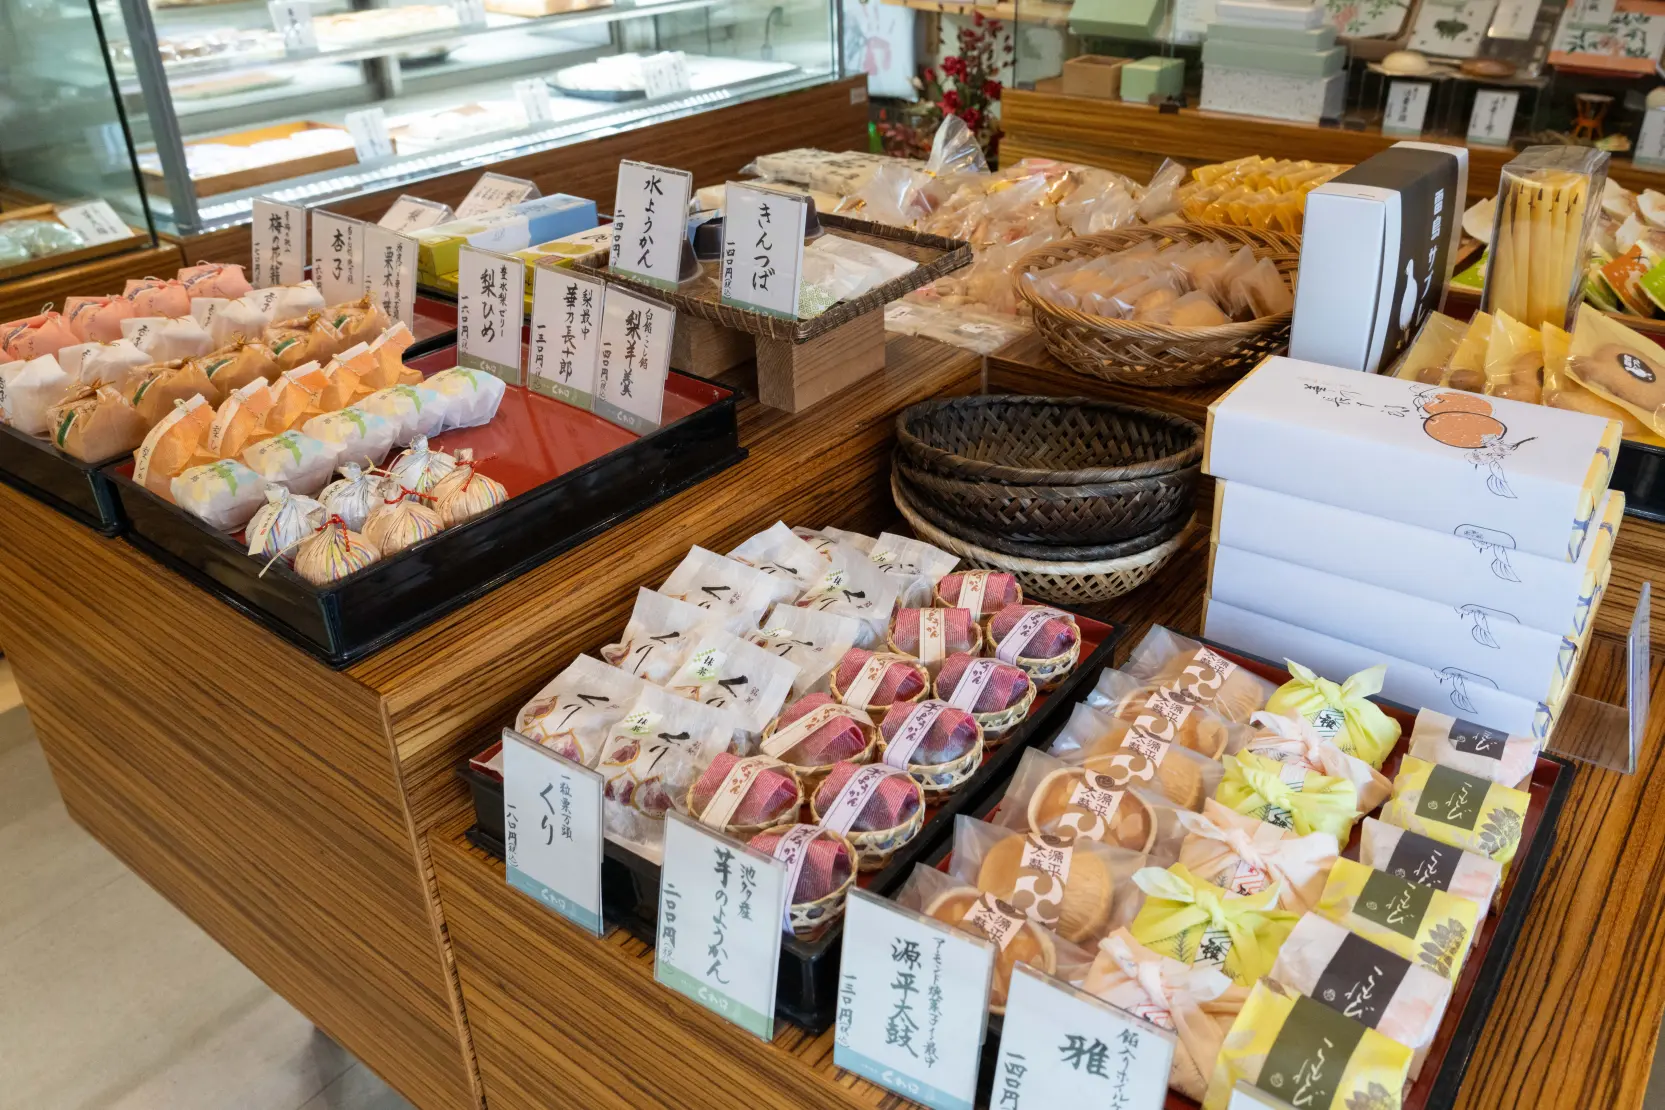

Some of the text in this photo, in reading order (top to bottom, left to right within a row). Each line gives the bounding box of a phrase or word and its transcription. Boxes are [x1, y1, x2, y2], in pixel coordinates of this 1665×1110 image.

[331, 228, 345, 281] 杏子
[637, 175, 663, 269] 水ようかん
[752, 203, 776, 291] きんつば
[479, 268, 497, 343] 梨ひめ
[580, 288, 593, 340] 梨最中
[620, 310, 642, 398] 梨羊羹
[539, 782, 555, 845] くり
[1095, 791, 1114, 817] 源平
[1047, 849, 1064, 878] 源平
[706, 846, 736, 985] 芋のようかん
[885, 937, 922, 1058] 源平太鼓
[1058, 1034, 1110, 1079] 雅
